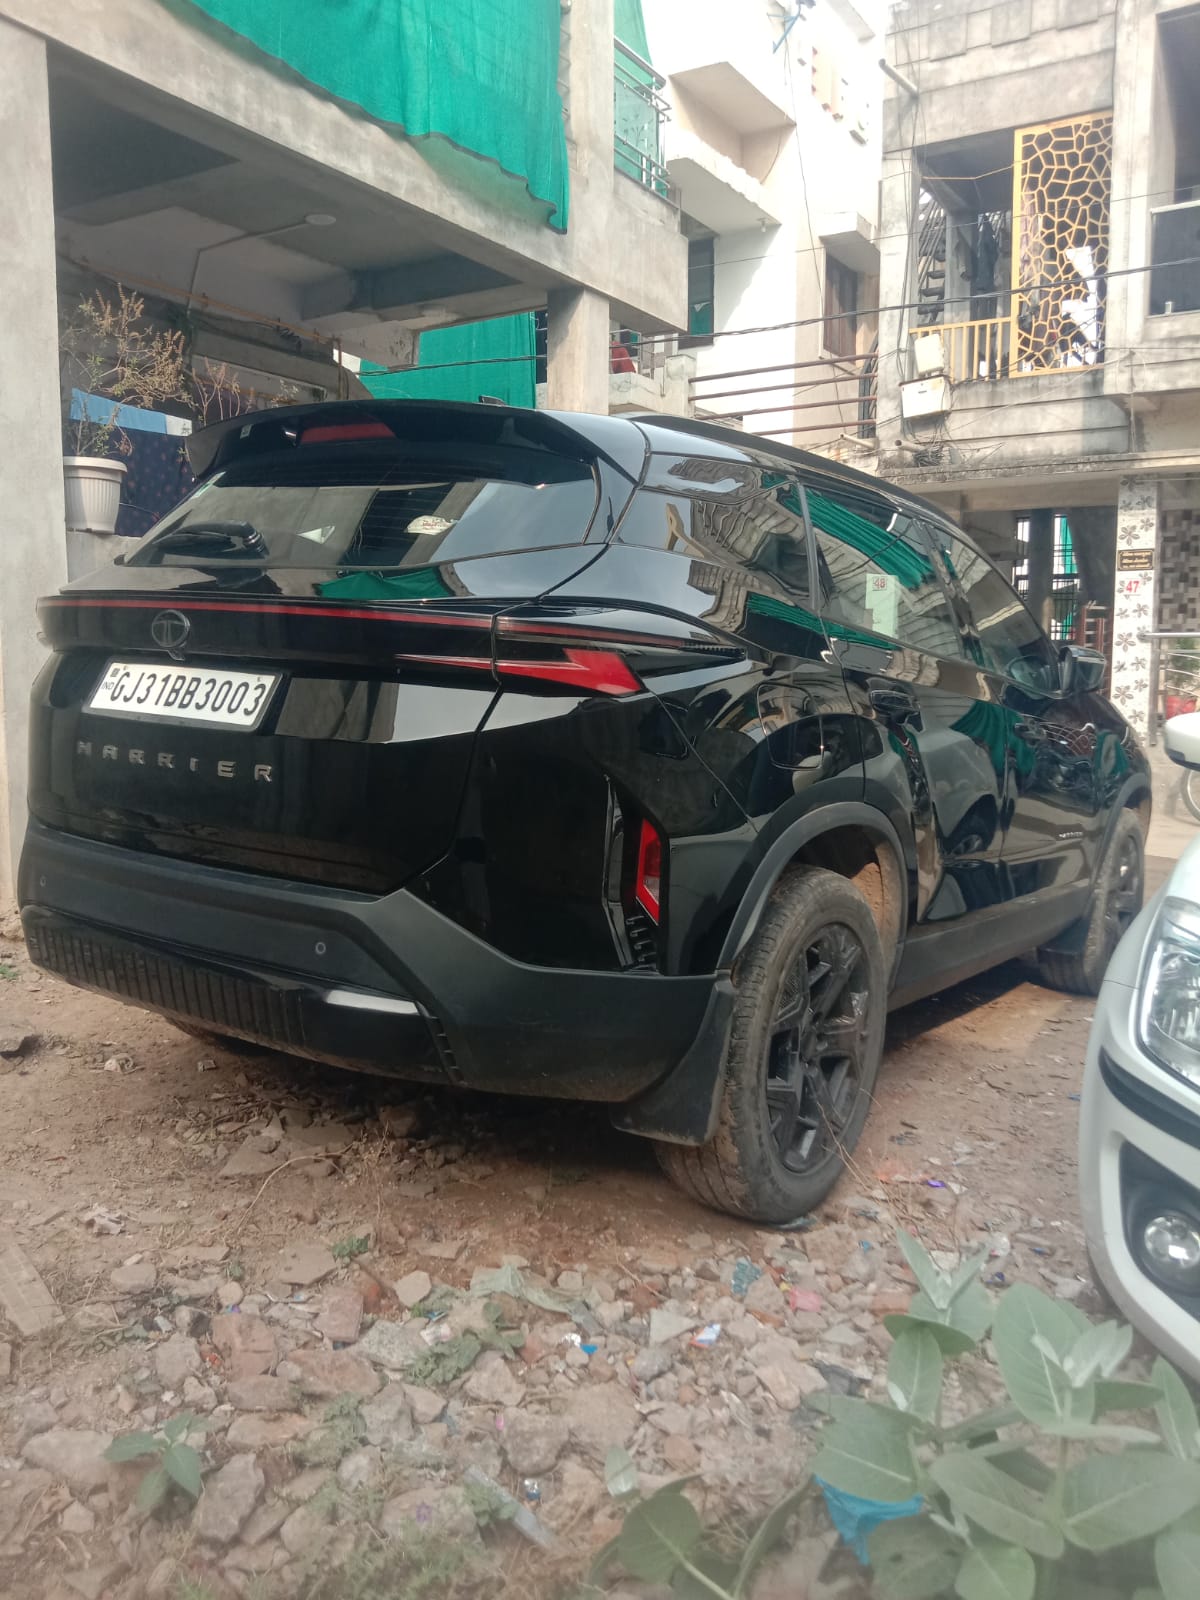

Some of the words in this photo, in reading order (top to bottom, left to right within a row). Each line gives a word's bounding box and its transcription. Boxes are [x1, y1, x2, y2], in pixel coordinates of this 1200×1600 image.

[1126, 580, 1140, 593] 47
[110, 671, 266, 716] GJ31BB3003
[77, 741, 273, 782] HARRIER
